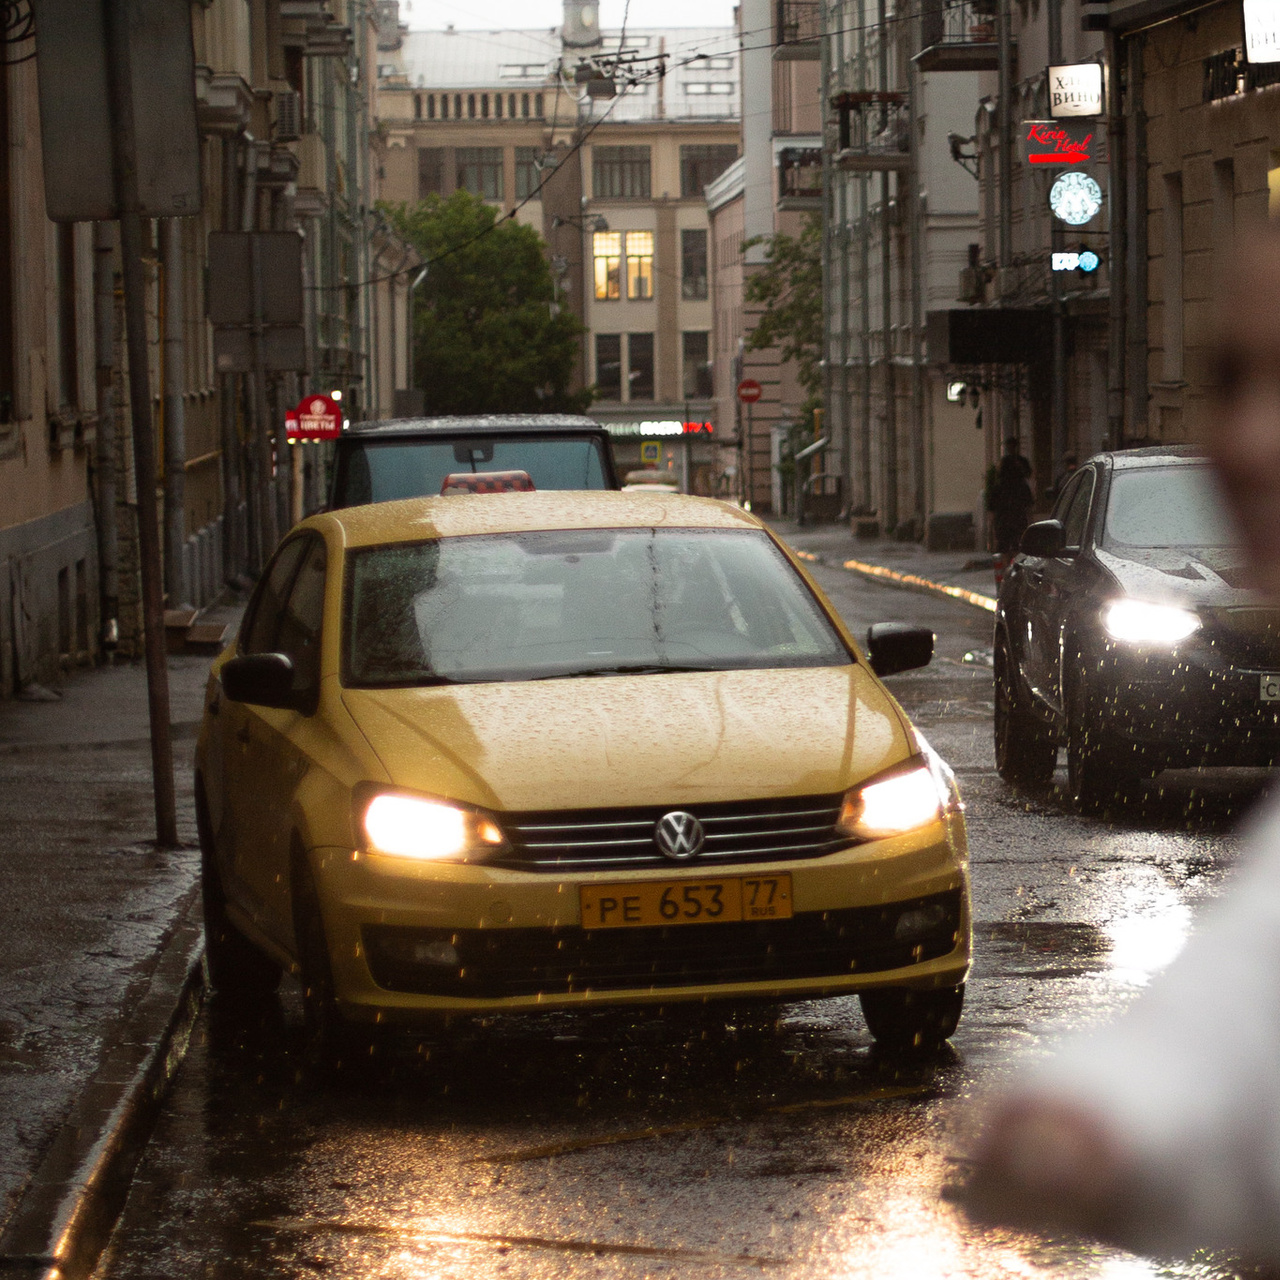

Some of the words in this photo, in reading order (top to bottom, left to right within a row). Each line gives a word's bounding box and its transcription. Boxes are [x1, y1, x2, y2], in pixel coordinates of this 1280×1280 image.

[1053, 91, 1101, 107] ВИНО
[1026, 124, 1068, 145] Kirin
[1054, 133, 1093, 152] Hotel
[659, 884, 725, 919] 653
[745, 879, 779, 906] 77
[751, 906, 776, 917] RUS
